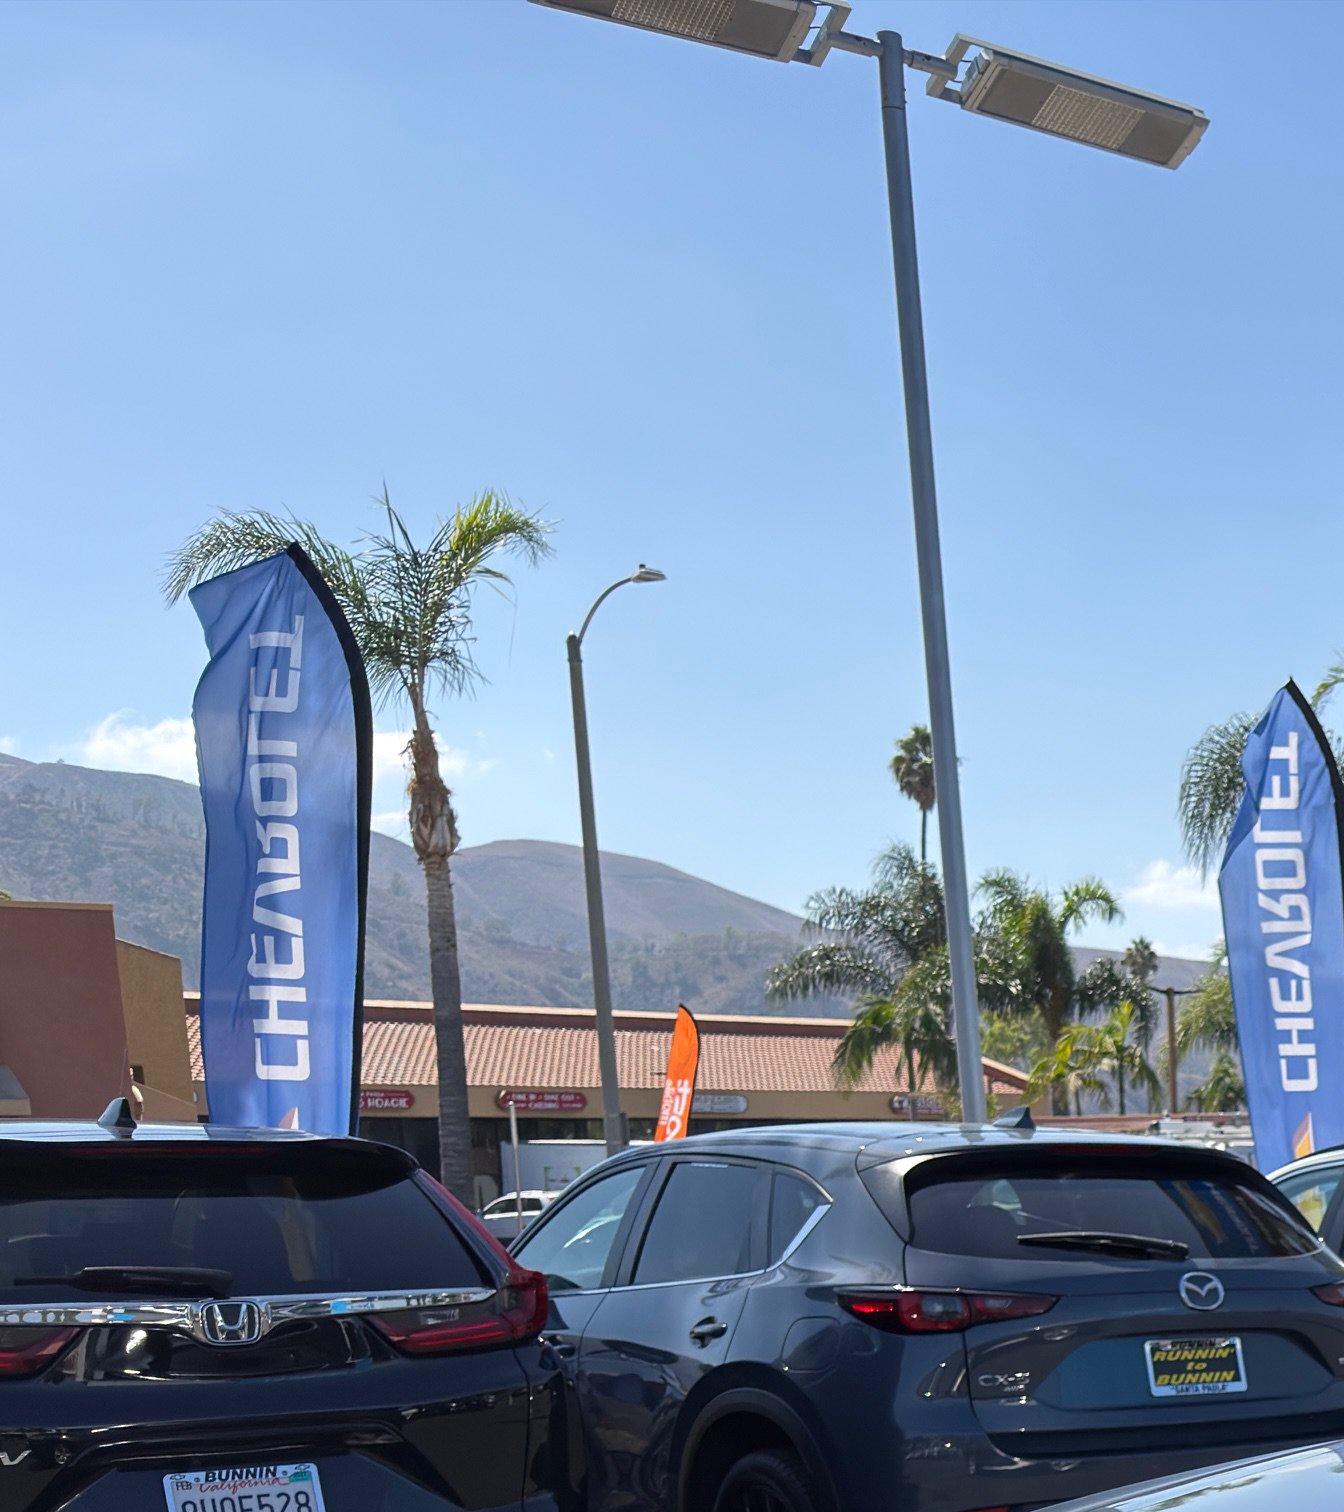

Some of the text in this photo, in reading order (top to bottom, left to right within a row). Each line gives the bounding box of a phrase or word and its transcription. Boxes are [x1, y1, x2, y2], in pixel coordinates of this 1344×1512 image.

[1153, 1347, 1235, 1362] RUNNIN'
[1186, 1361, 1208, 1371] to
[978, 1371, 1030, 1387] CX-5
[1156, 1370, 1235, 1386] BUNNIN
[204, 1465, 278, 1483] BUNNIN
[175, 1481, 193, 1491] FEB
[199, 1477, 291, 1495] California
